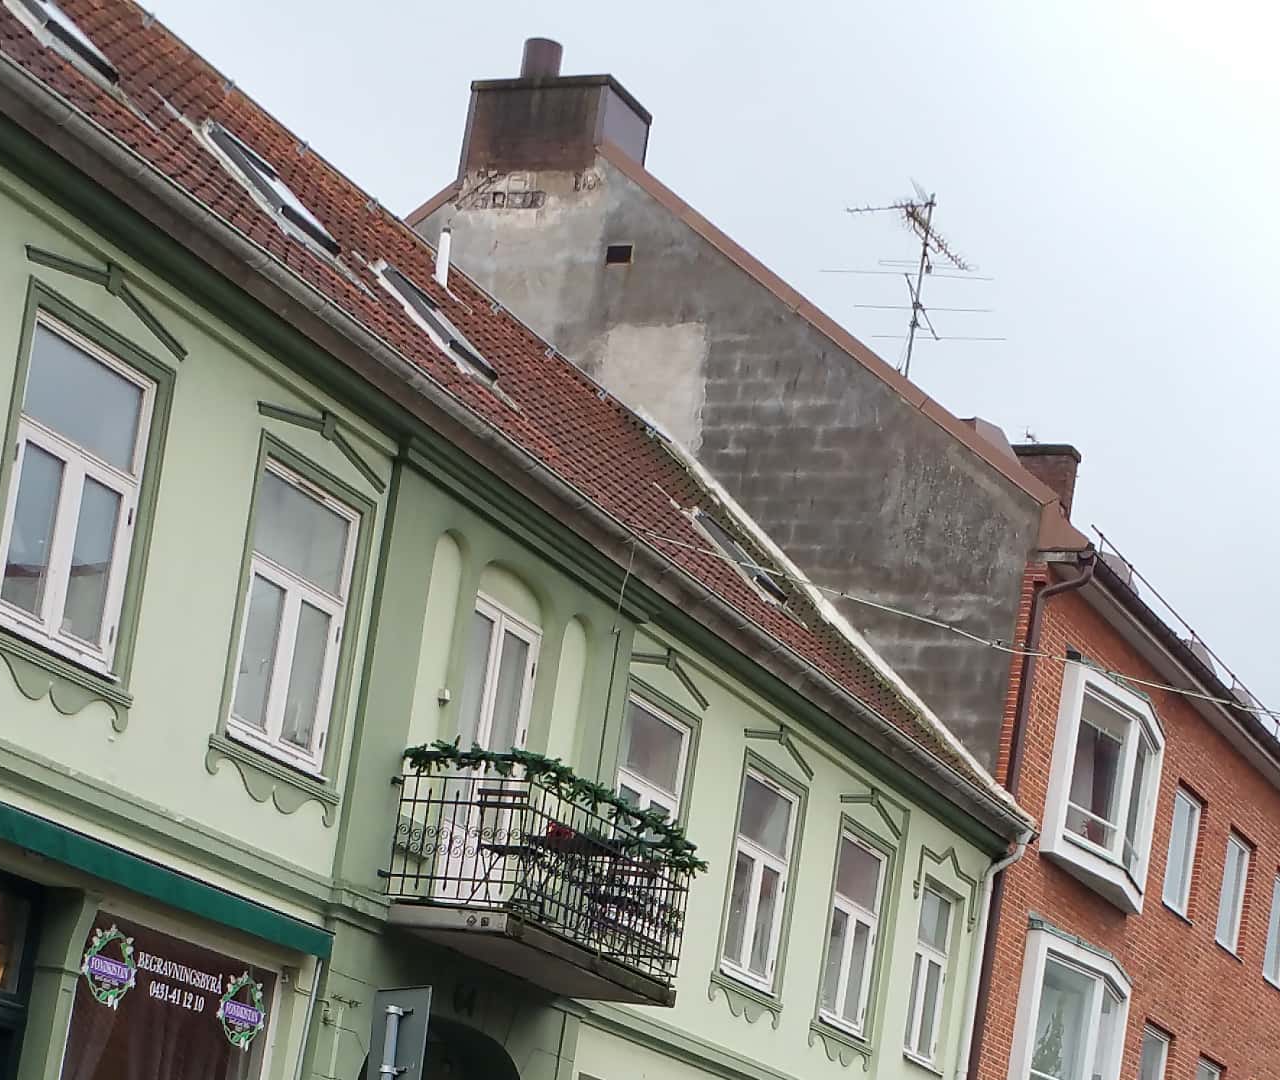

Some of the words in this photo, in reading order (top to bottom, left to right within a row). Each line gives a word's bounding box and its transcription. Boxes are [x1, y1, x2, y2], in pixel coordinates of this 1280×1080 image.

[137, 951, 223, 995] BEGRAVNINGSBYRÅ
[182, 991, 194, 1010] 12
[193, 995, 205, 1013] 10
